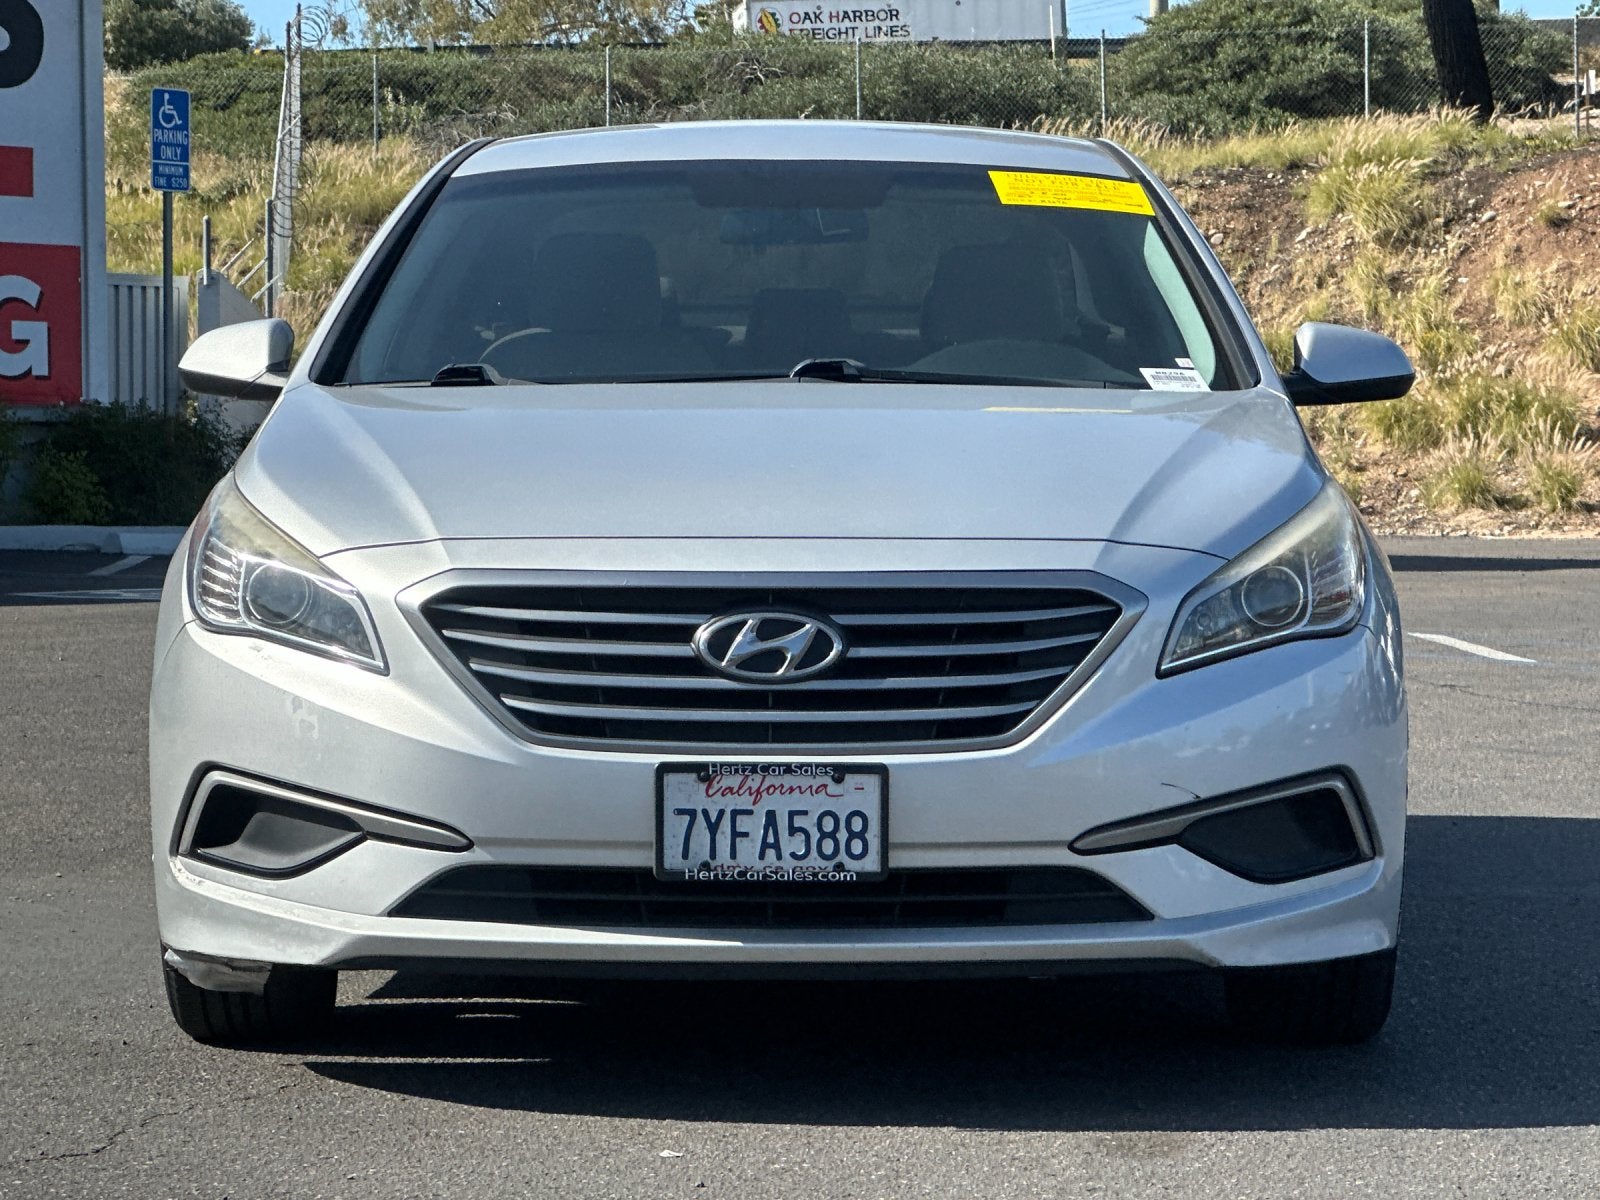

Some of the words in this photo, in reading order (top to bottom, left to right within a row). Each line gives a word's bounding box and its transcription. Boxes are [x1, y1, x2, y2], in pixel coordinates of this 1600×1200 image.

[789, 11, 824, 24] OAK
[829, 9, 900, 23] HARBOR
[865, 25, 911, 39] LINES
[153, 128, 188, 145] PARKING
[160, 145, 182, 160] ONLY
[158, 164, 184, 175] MINIMUM
[154, 176, 168, 187] FINE
[171, 177, 188, 188] $250
[708, 763, 753, 776] Hertz
[757, 763, 787, 776] Car
[791, 763, 834, 776] Sales
[705, 774, 844, 806] California
[673, 808, 869, 861] 7YFA588
[685, 868, 856, 881] HertzCarSales.com
